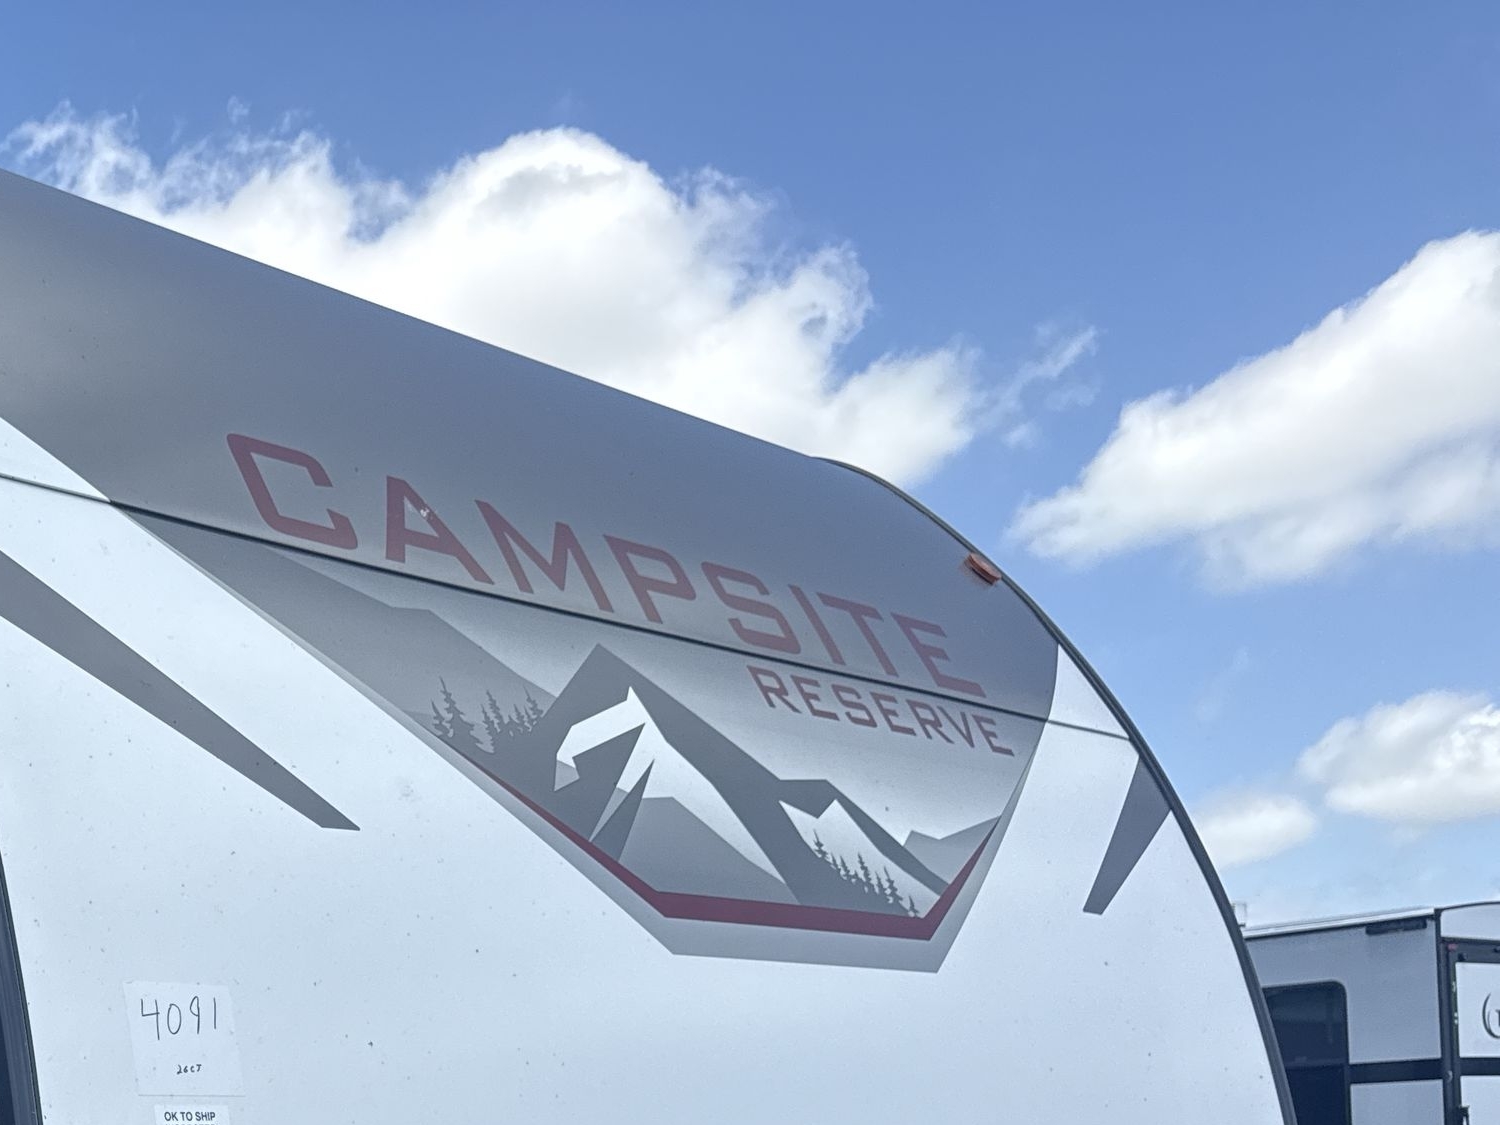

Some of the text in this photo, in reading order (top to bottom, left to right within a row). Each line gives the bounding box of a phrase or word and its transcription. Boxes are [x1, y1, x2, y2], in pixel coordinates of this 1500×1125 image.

[226, 433, 986, 697] CAMPSITE
[746, 665, 1016, 757] RESERVE
[141, 996, 217, 1040] 4091
[164, 1111, 216, 1121] OK TO SHIP
